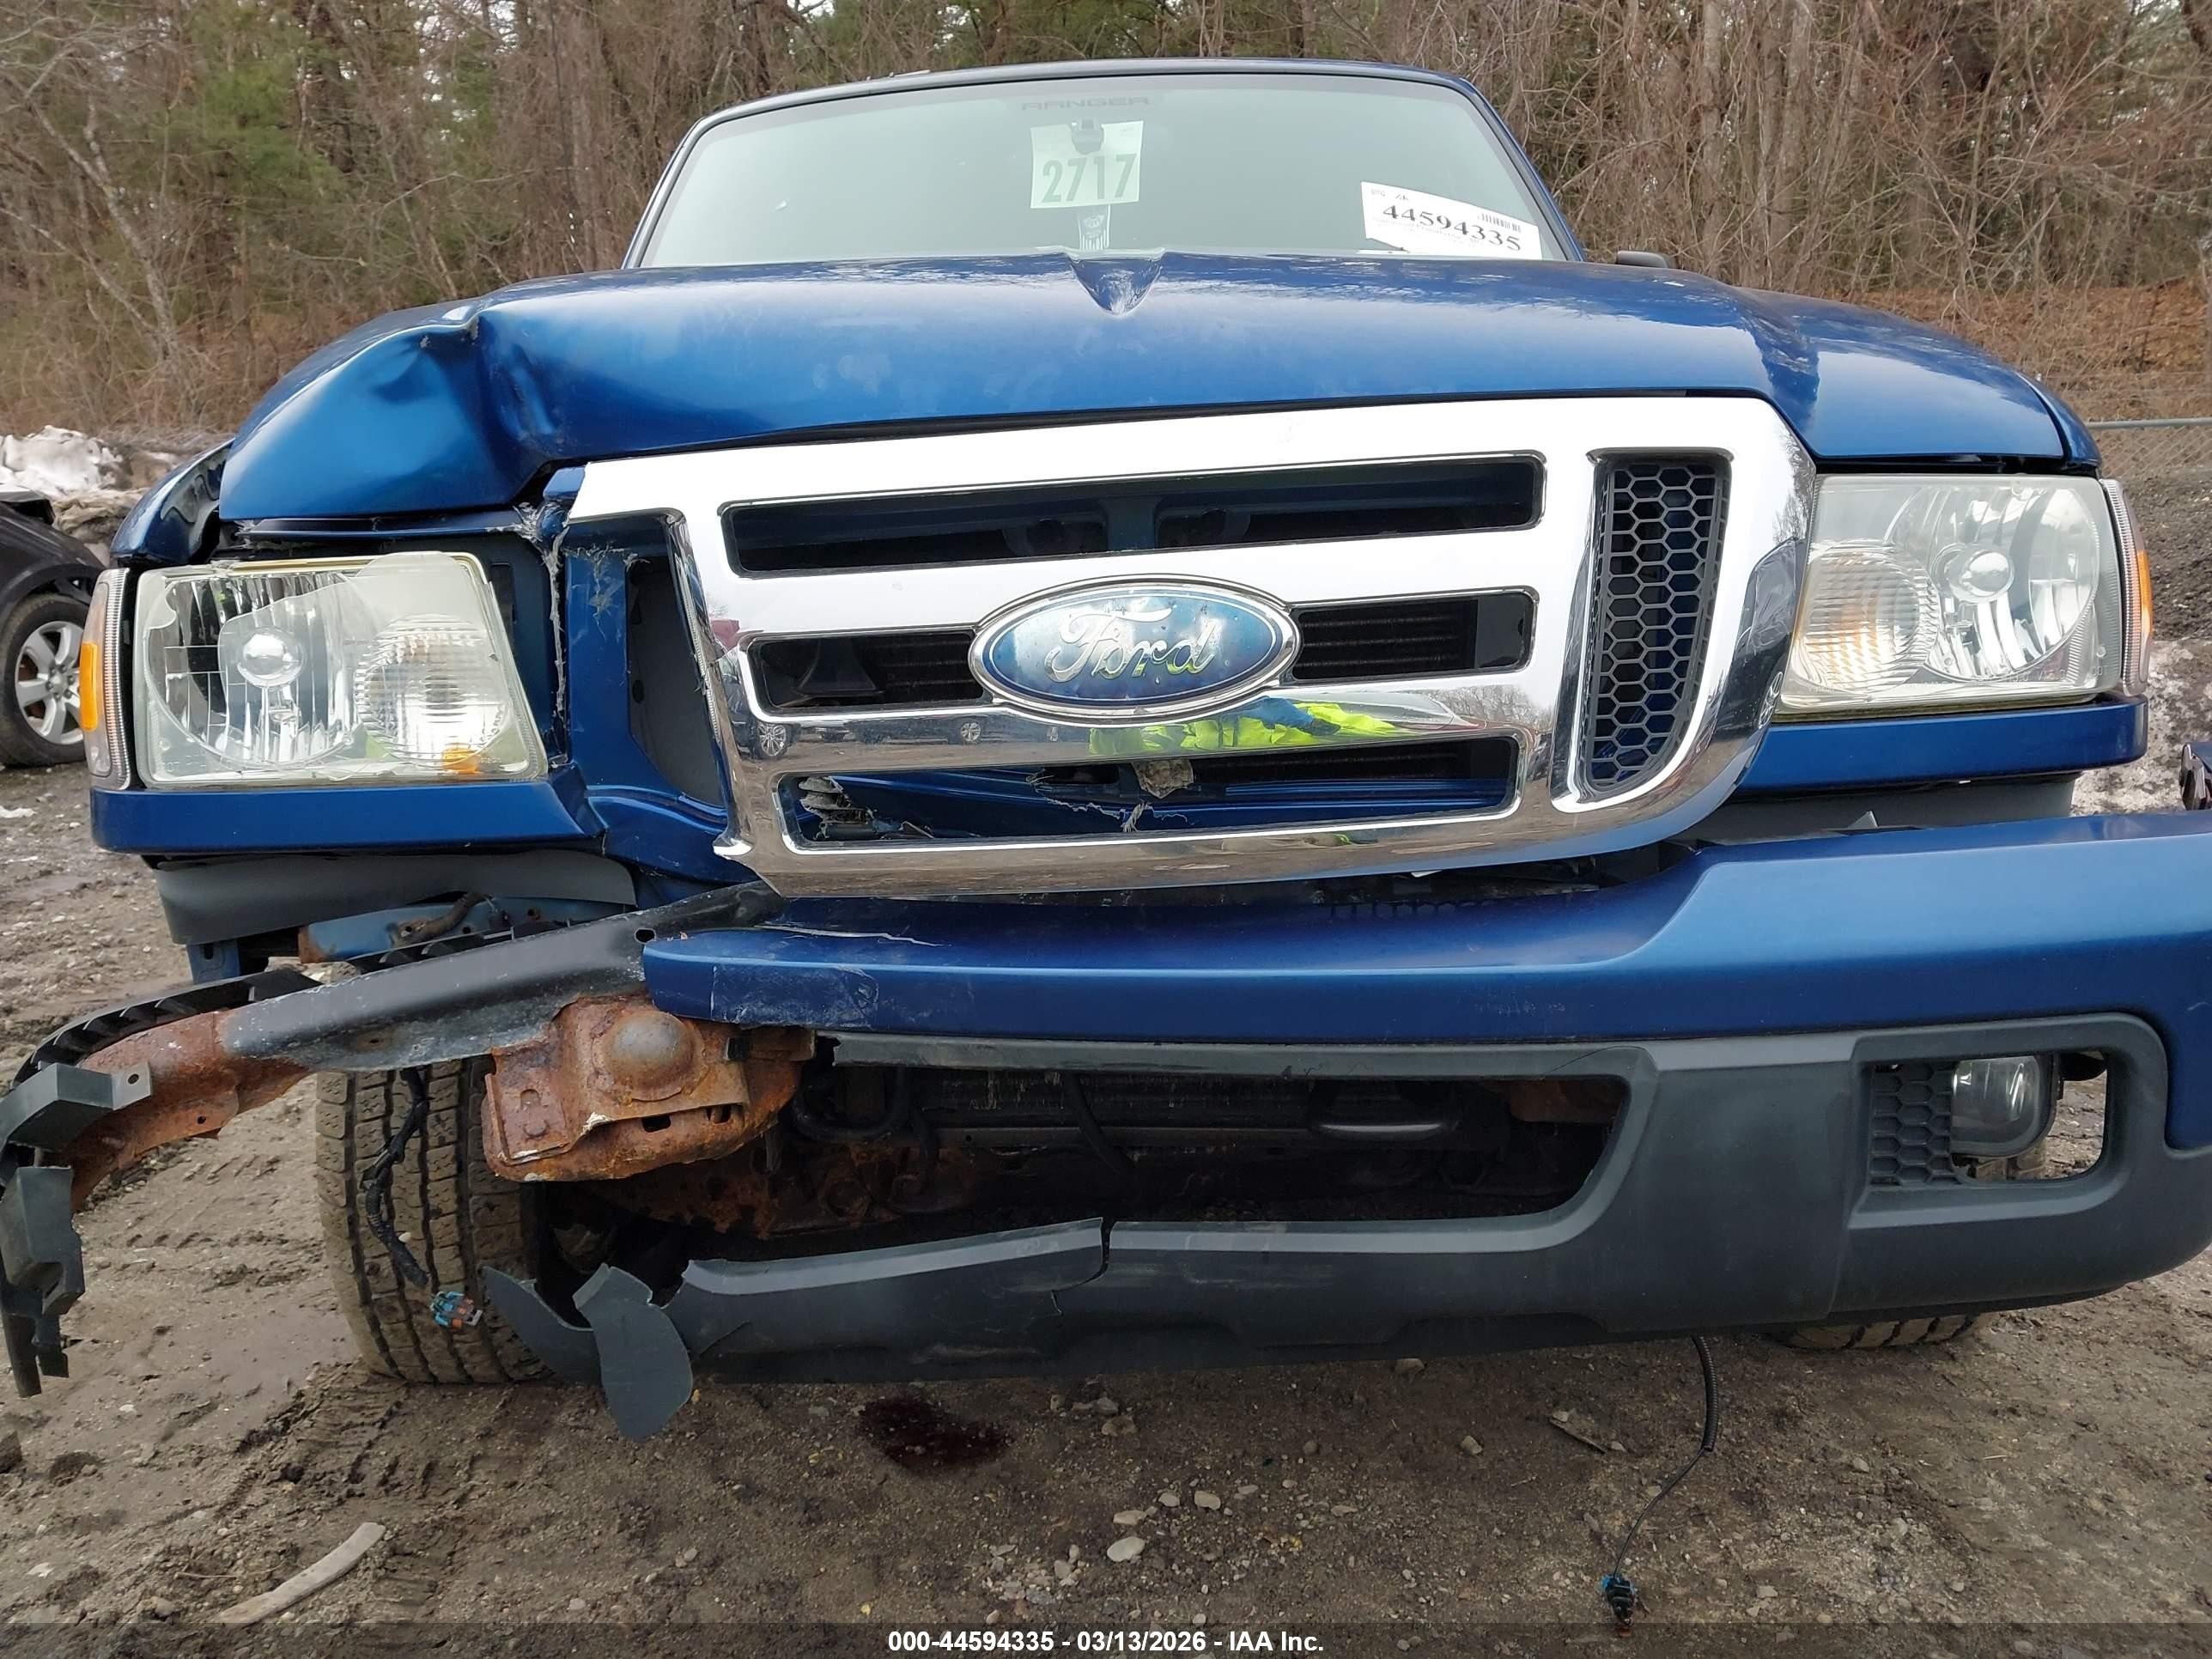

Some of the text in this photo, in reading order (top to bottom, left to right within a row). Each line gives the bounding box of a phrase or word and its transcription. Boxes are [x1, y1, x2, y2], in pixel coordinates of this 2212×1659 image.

[1021, 96, 1151, 111] RANGER
[1041, 152, 1138, 204] 2717
[1382, 204, 1522, 252] 44594335
[1043, 606, 1218, 684] Ford
